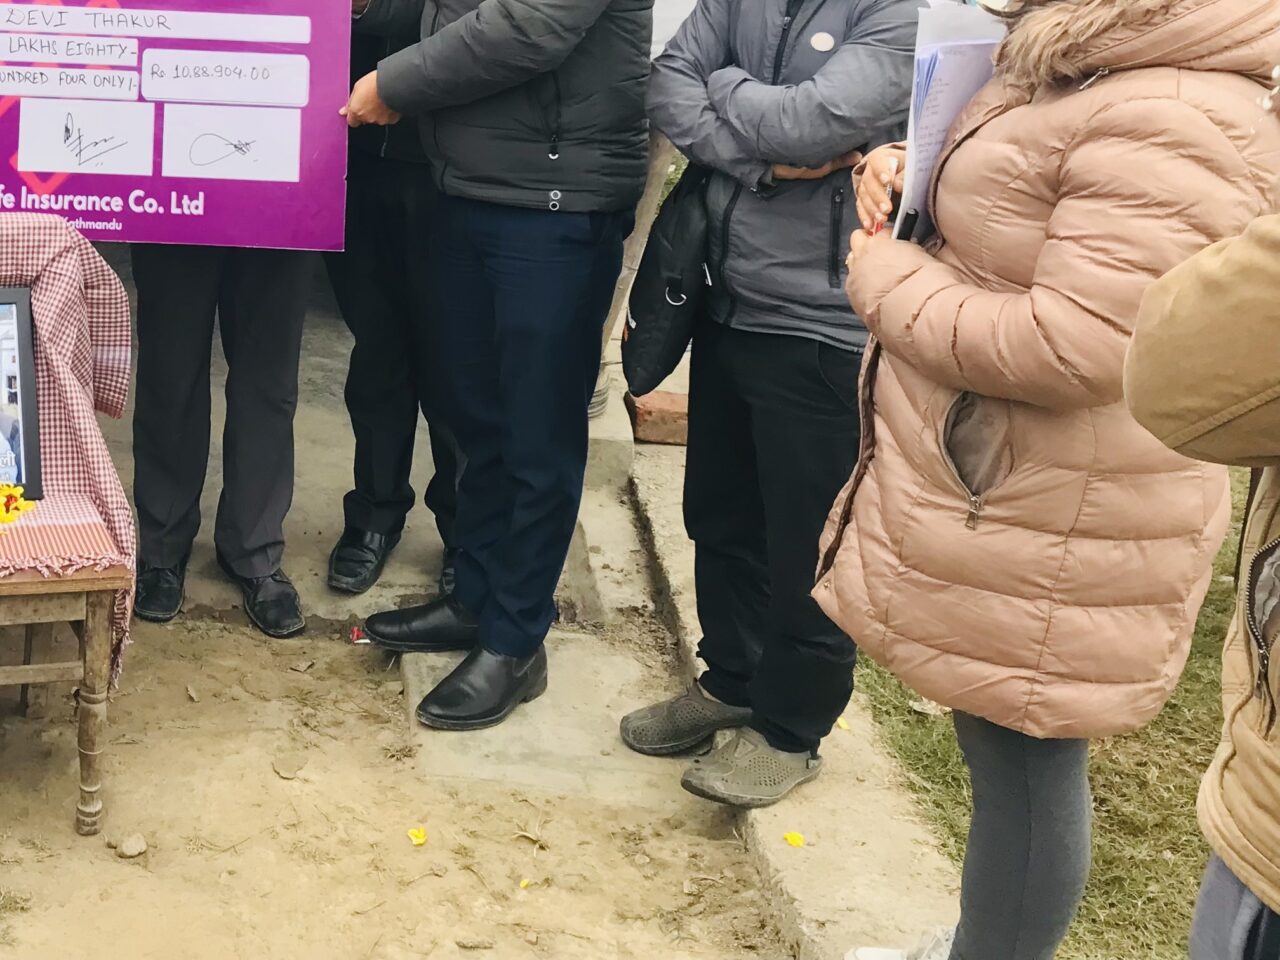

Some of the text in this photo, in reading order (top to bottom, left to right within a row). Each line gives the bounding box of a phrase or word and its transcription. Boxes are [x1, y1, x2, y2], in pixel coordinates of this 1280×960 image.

[6, 7, 69, 28] DEVI
[84, 12, 172, 30] THAKUR
[8, 36, 58, 55] LAKHS
[58, 71, 87, 86] FOUR
[93, 73, 126, 88] ONLY
[20, 186, 124, 212] Insurance
[128, 189, 164, 214] Co.
[170, 191, 205, 216] Ltd
